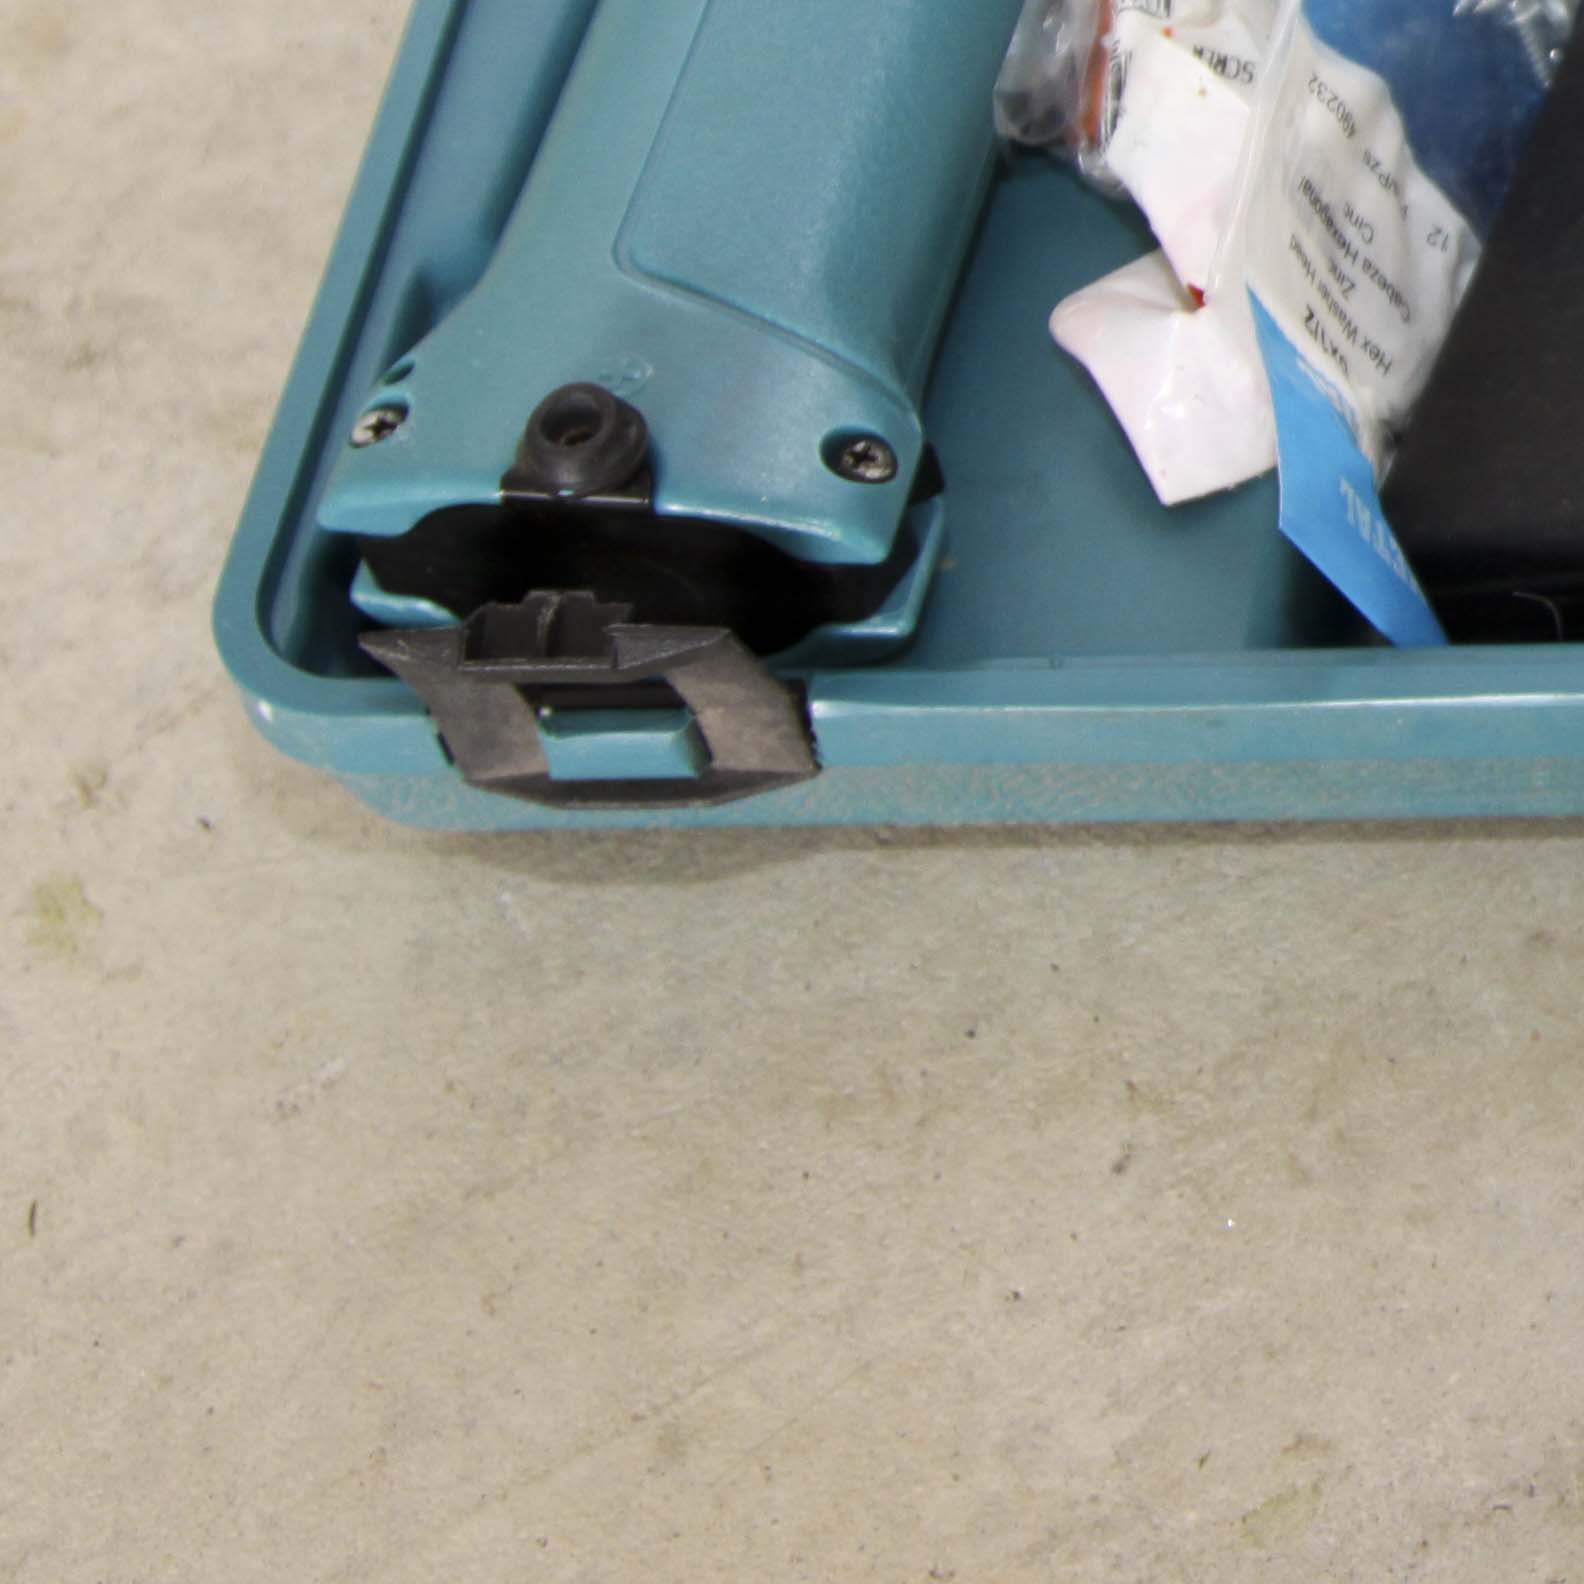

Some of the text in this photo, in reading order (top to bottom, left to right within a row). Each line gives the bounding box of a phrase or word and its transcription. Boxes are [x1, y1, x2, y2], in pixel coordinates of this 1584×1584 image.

[1278, 232, 1325, 287] Head
[1290, 171, 1417, 327] Cabeza Hexagonal
[1318, 253, 1361, 302] Zinc
[1311, 277, 1366, 345] Washer
[1356, 330, 1399, 378] Hex
